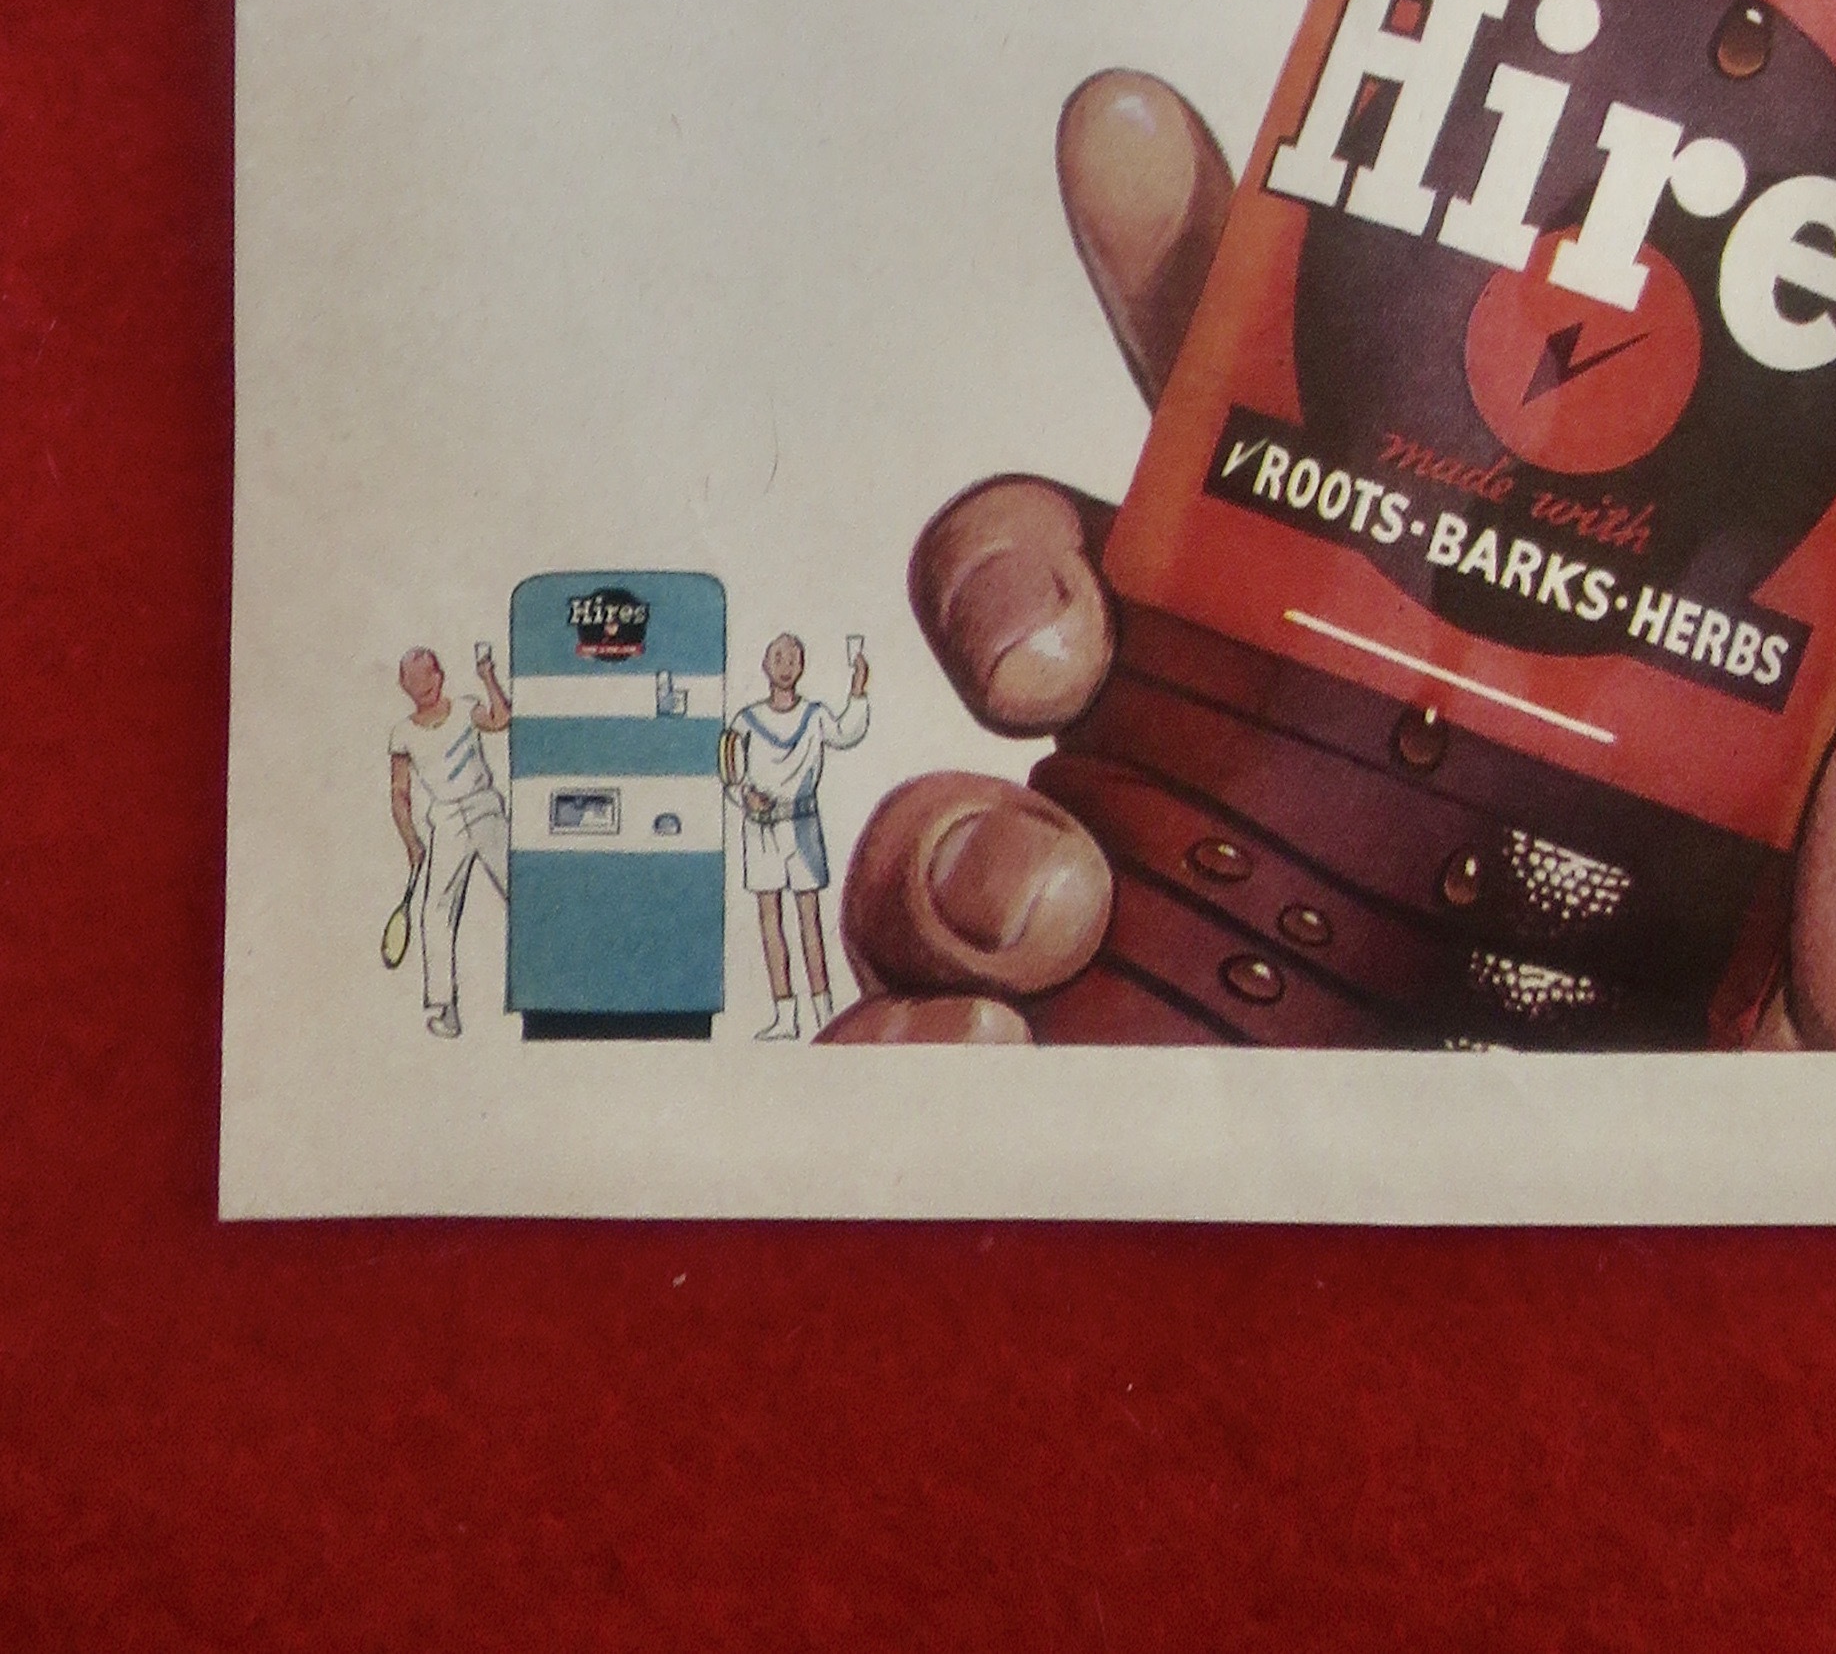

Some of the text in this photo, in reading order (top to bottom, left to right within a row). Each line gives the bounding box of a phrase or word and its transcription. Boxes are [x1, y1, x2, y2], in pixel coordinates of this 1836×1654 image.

[1378, 432, 1655, 555] made with
[570, 595, 646, 625] Hires
